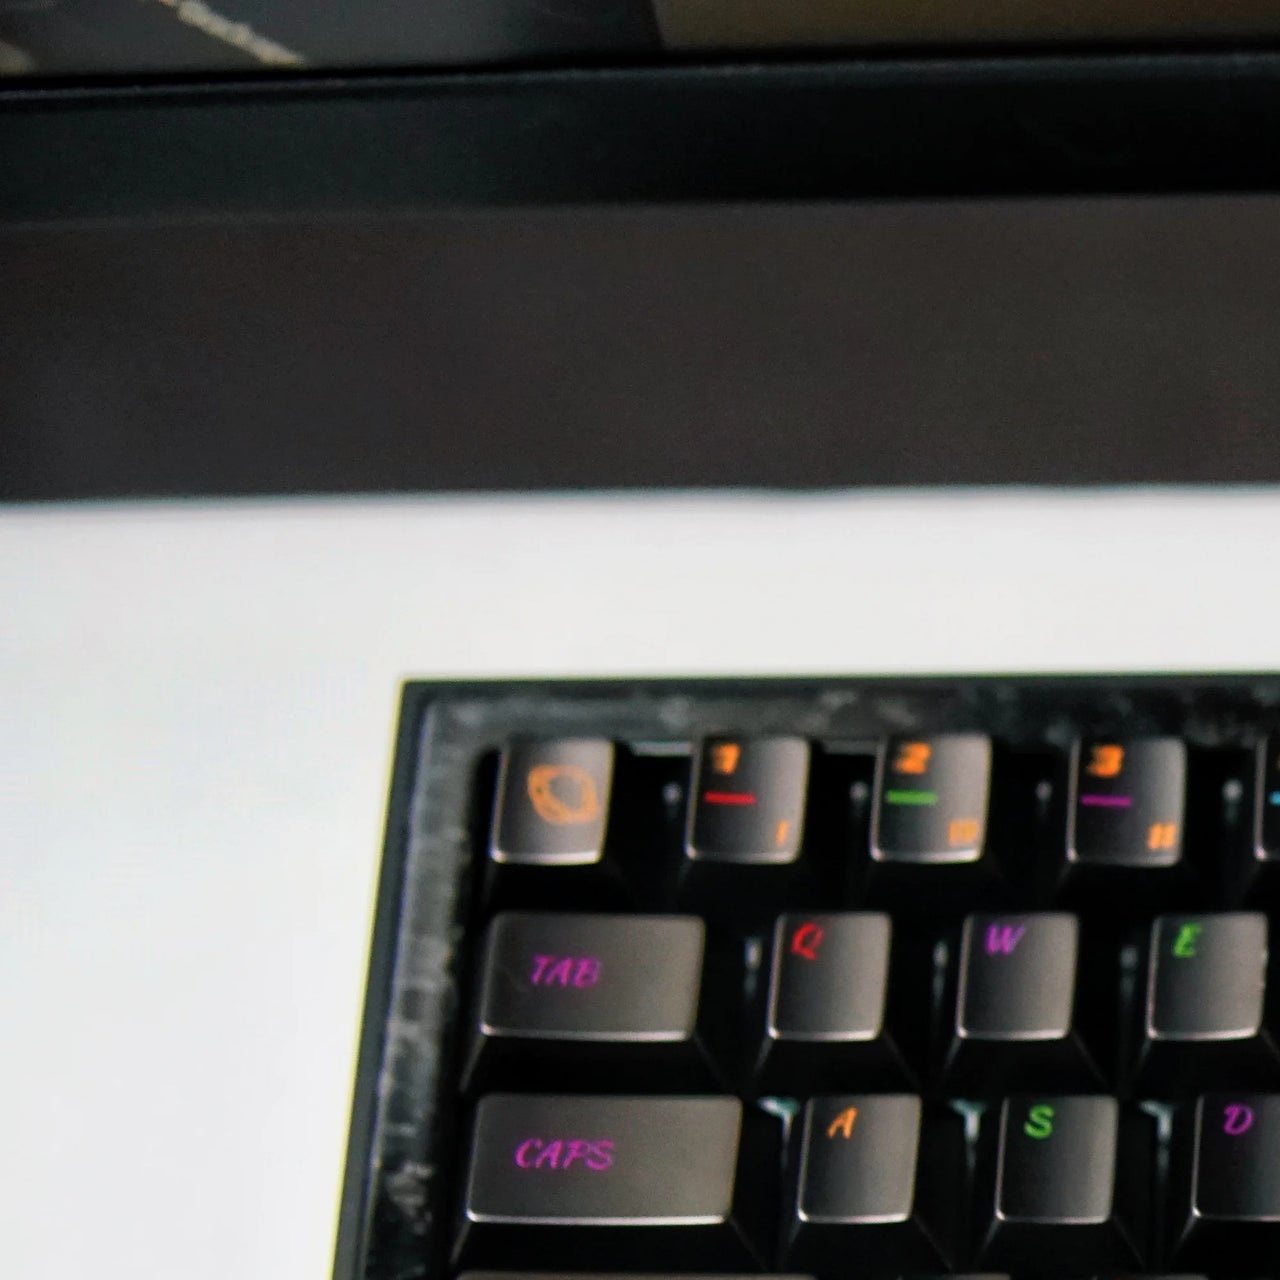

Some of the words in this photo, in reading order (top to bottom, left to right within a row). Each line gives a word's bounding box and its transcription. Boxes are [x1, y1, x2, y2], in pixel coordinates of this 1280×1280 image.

[717, 743, 740, 774] 1
[898, 742, 931, 774] 2
[1093, 745, 1123, 777] 3
[791, 922, 823, 960] Q
[985, 924, 1021, 955] W
[1173, 923, 1199, 957] E
[531, 955, 598, 988] TAB
[828, 1107, 858, 1138] A
[1025, 1104, 1055, 1139] S
[1223, 1104, 1254, 1136] D
[514, 1139, 614, 1171] CAPS
